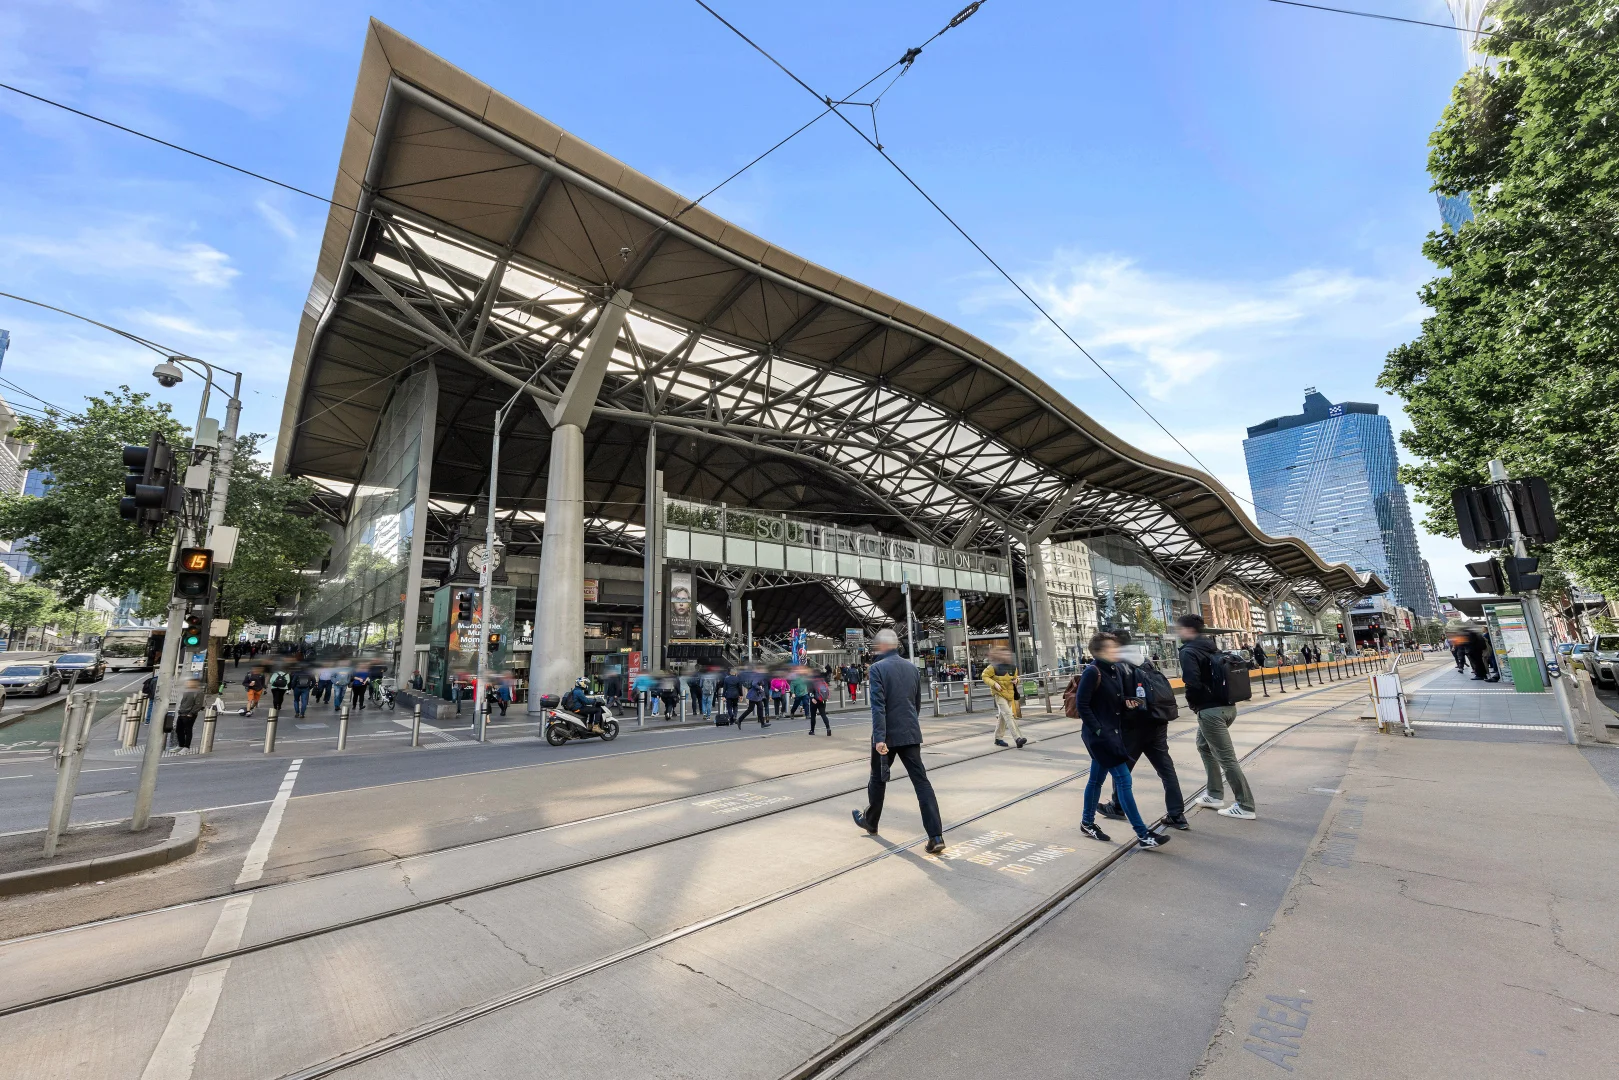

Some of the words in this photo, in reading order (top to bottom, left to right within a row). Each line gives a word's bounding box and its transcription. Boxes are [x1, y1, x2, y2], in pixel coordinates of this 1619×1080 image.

[757, 518, 859, 552] SOUTHERN
[866, 537, 915, 560] CROSS
[191, 555, 207, 568] 15
[996, 838, 1037, 853] WAY
[998, 863, 1036, 876] TO
[1017, 845, 1076, 866] TRAMS
[1243, 994, 1314, 1073] AREA
